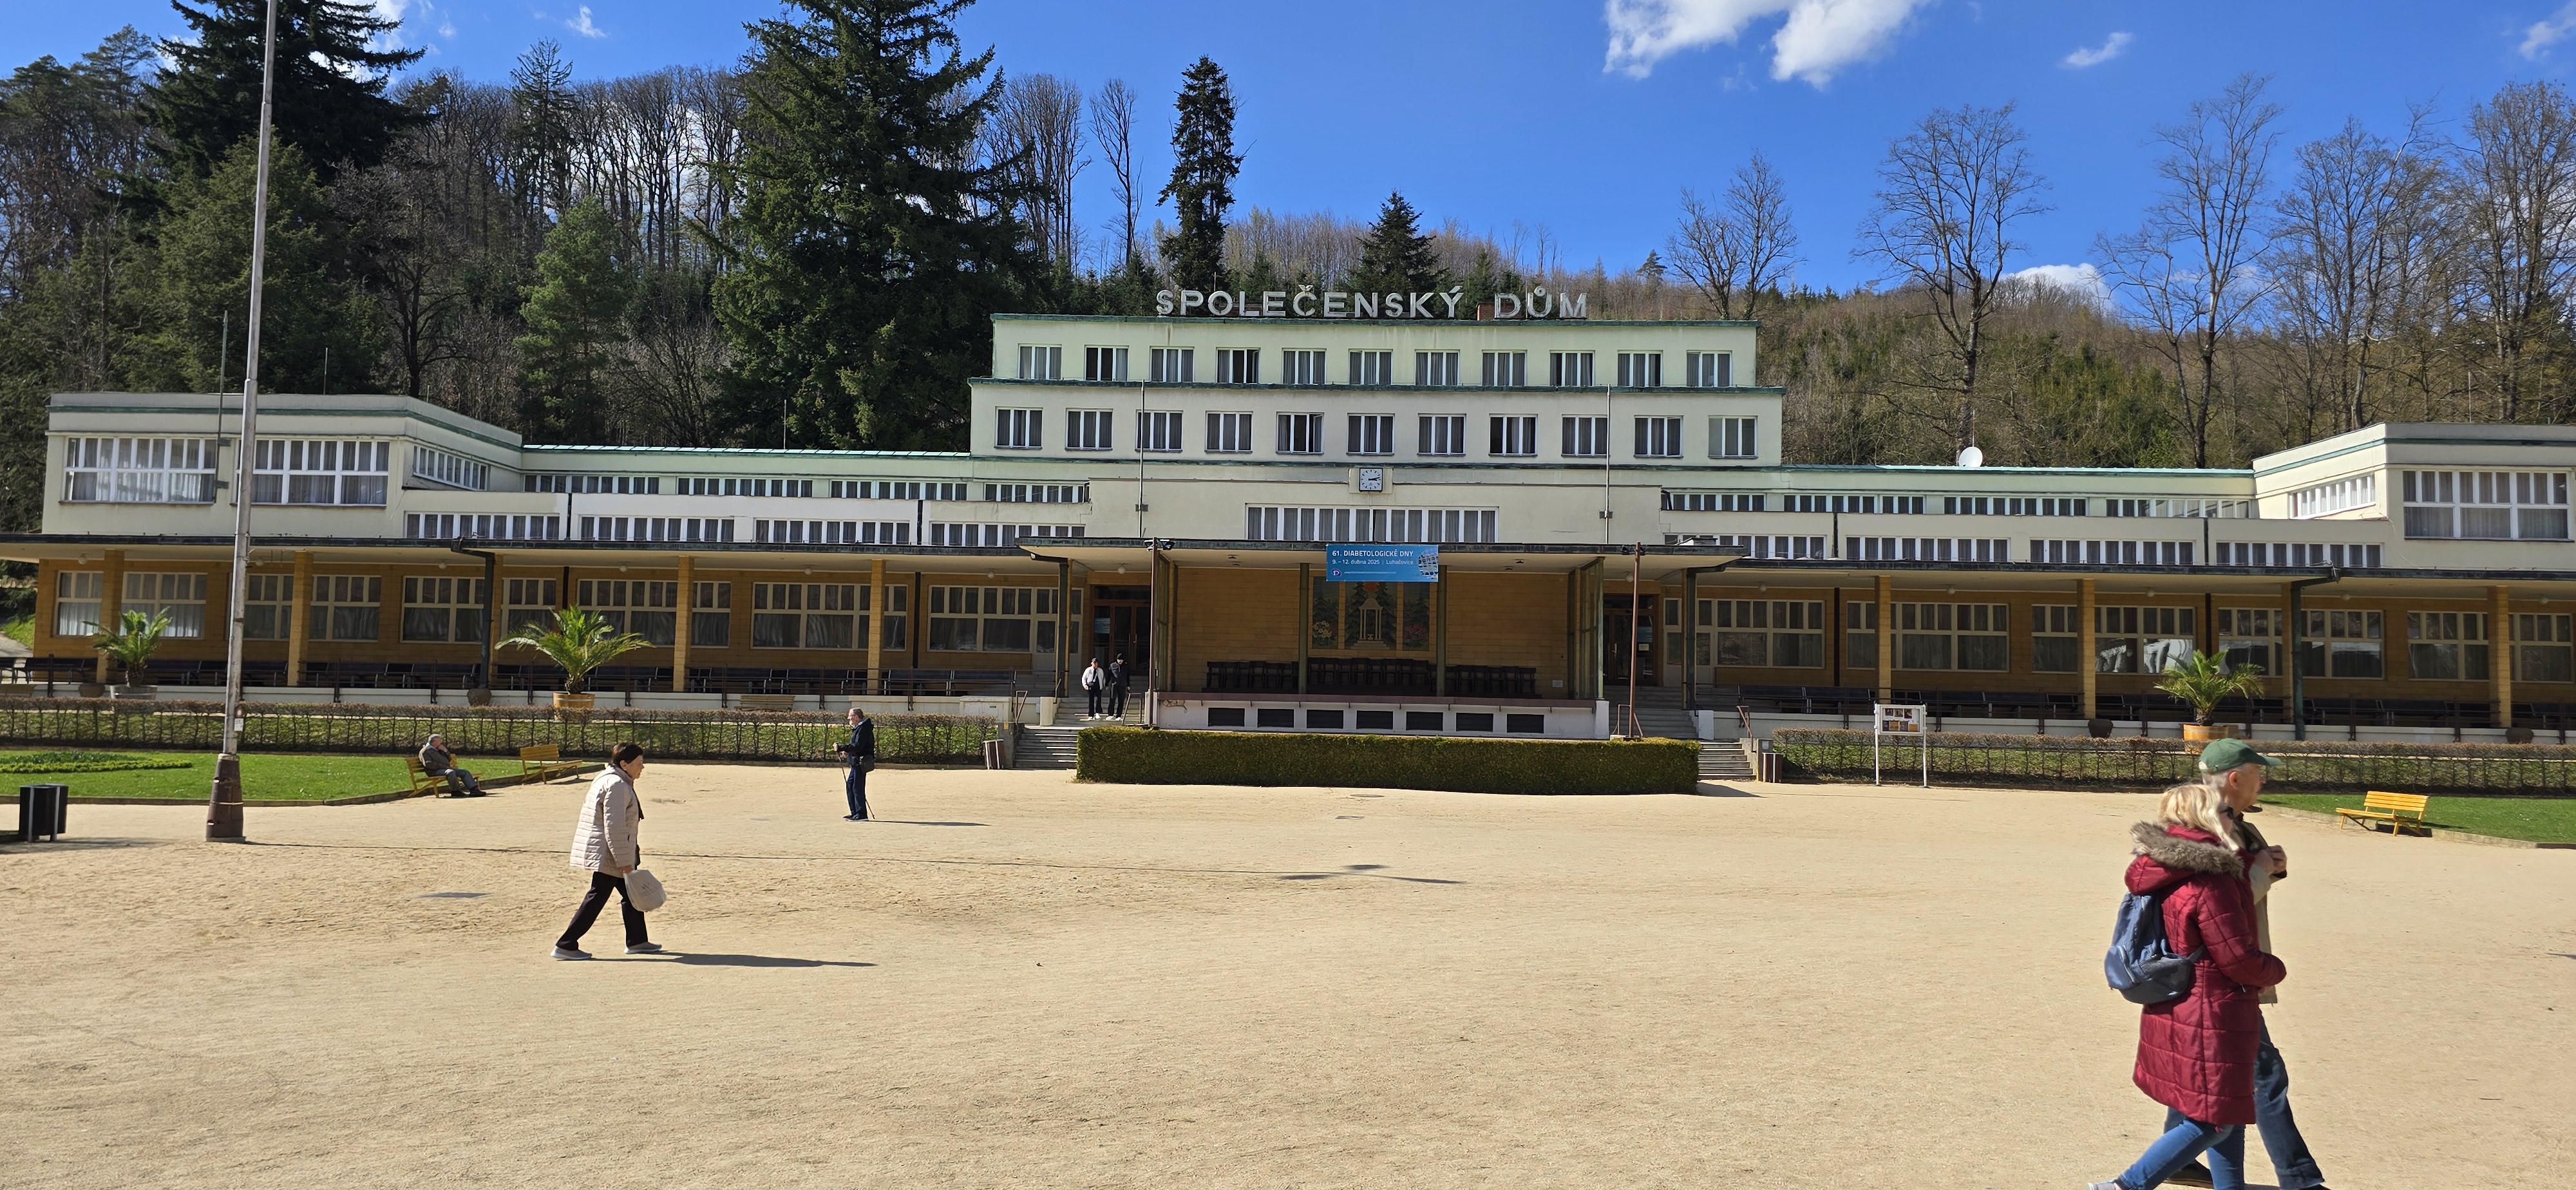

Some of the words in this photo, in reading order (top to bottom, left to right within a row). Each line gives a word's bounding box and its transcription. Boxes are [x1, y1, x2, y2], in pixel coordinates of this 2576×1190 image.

[1156, 284, 1464, 317] SPOLEČENSKÝ
[1494, 285, 1587, 318] DŮM
[1343, 549, 1398, 557] DIABETOLOGICKÉ
